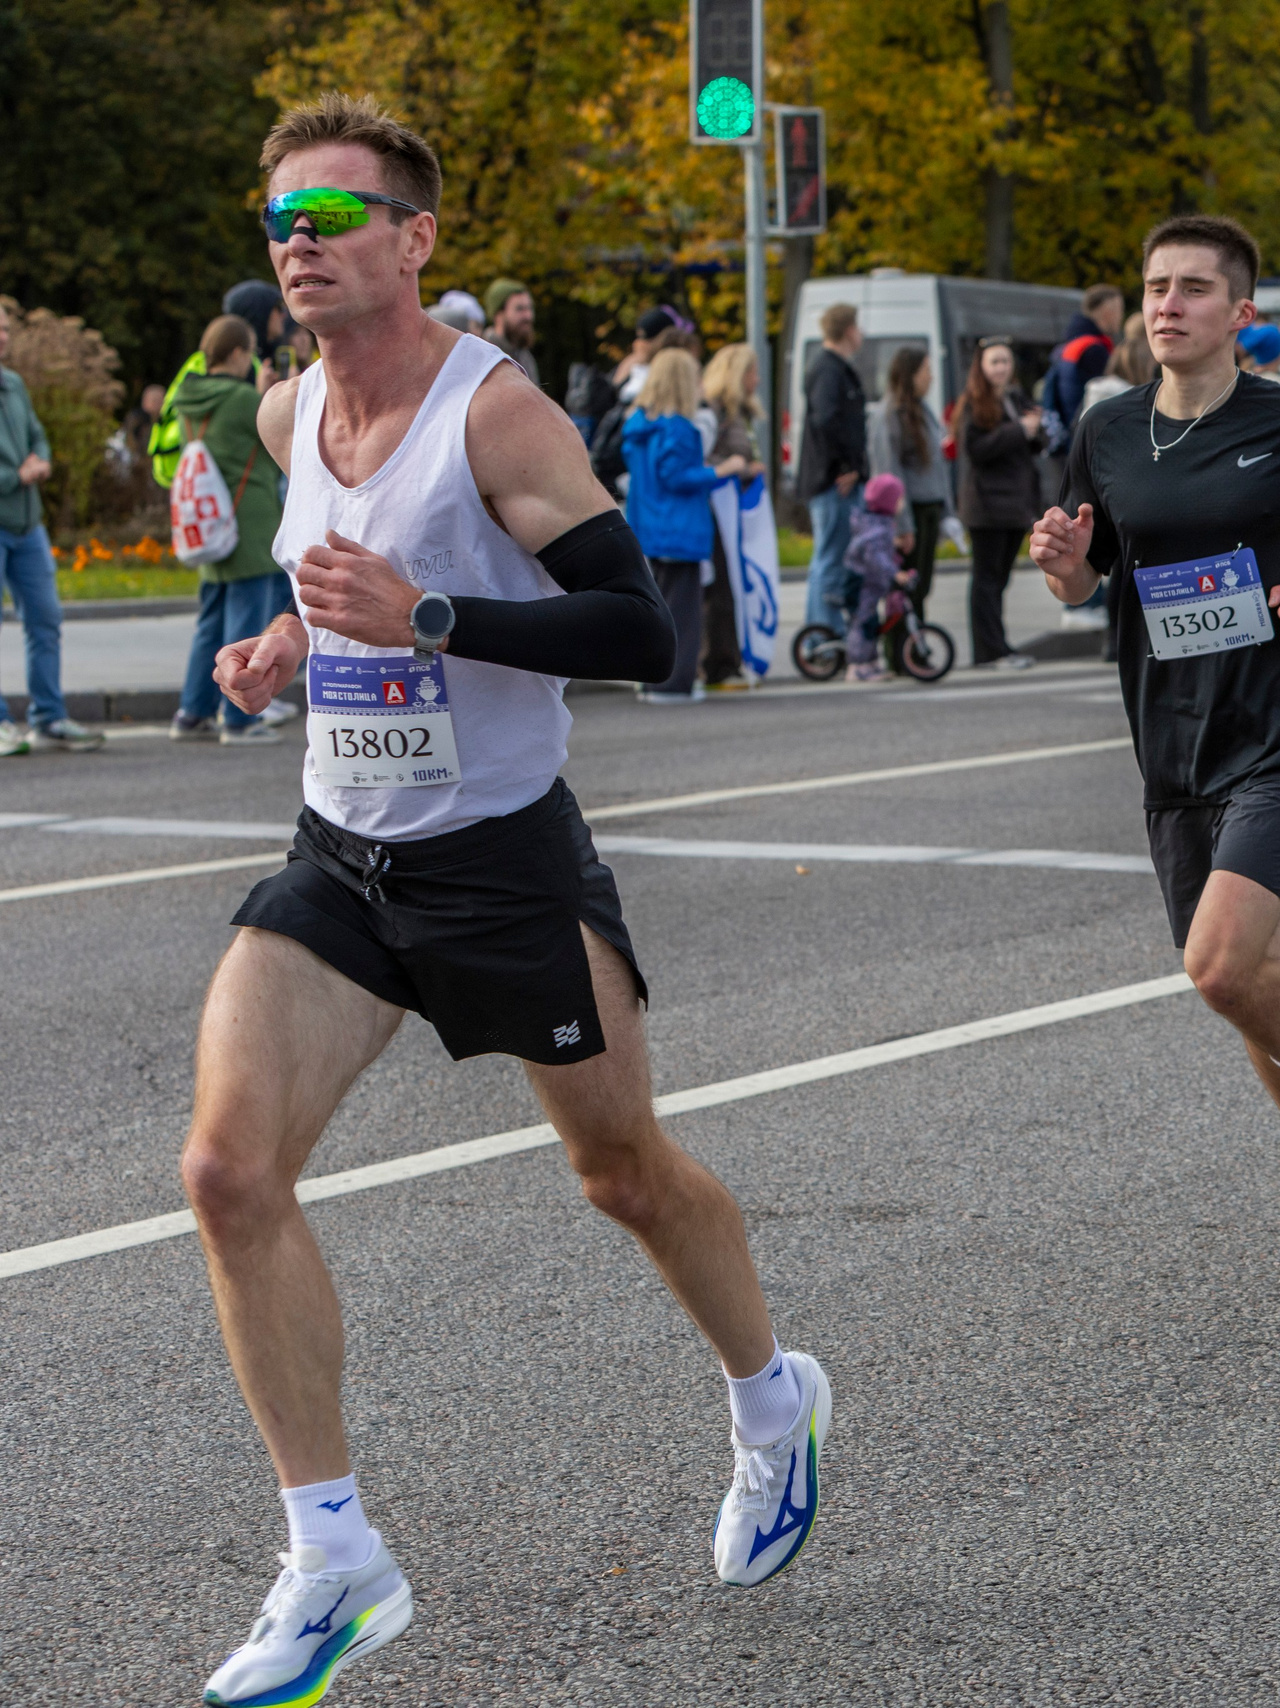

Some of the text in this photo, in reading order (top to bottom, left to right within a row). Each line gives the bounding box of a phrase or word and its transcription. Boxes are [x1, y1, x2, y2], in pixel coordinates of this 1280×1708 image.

[1164, 587, 1195, 597] СТОЛИЦА
[1159, 606, 1238, 638] 13302
[416, 664, 431, 672] ПСБ
[322, 690, 377, 701] МОЯ СТОЛИЦА
[328, 727, 433, 759] 13802
